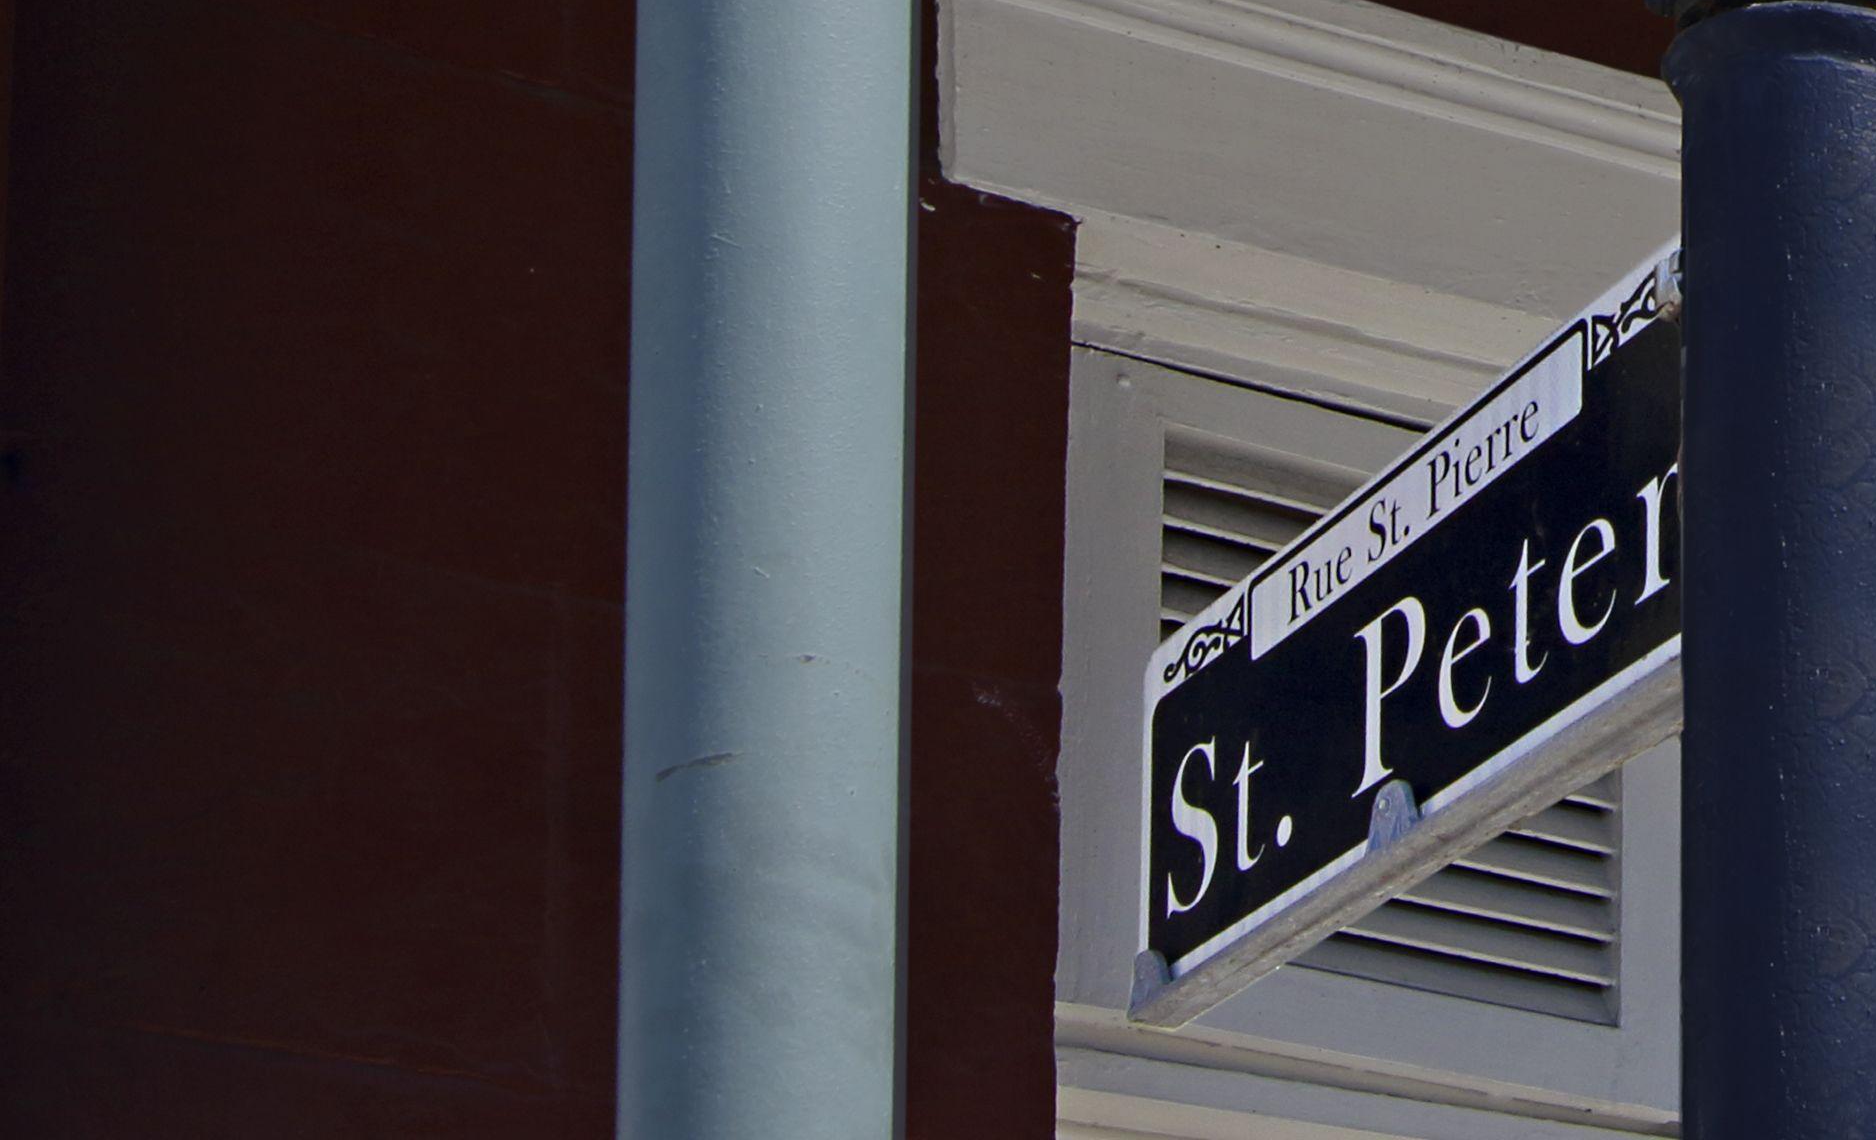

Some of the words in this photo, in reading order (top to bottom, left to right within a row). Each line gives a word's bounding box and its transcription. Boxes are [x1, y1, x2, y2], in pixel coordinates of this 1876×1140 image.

[1287, 541, 1353, 626] Rue
[1368, 499, 1411, 564] St.
[1425, 396, 1540, 521] Pierre
[1165, 735, 1294, 919] St.
[1351, 463, 1682, 799] Peter
